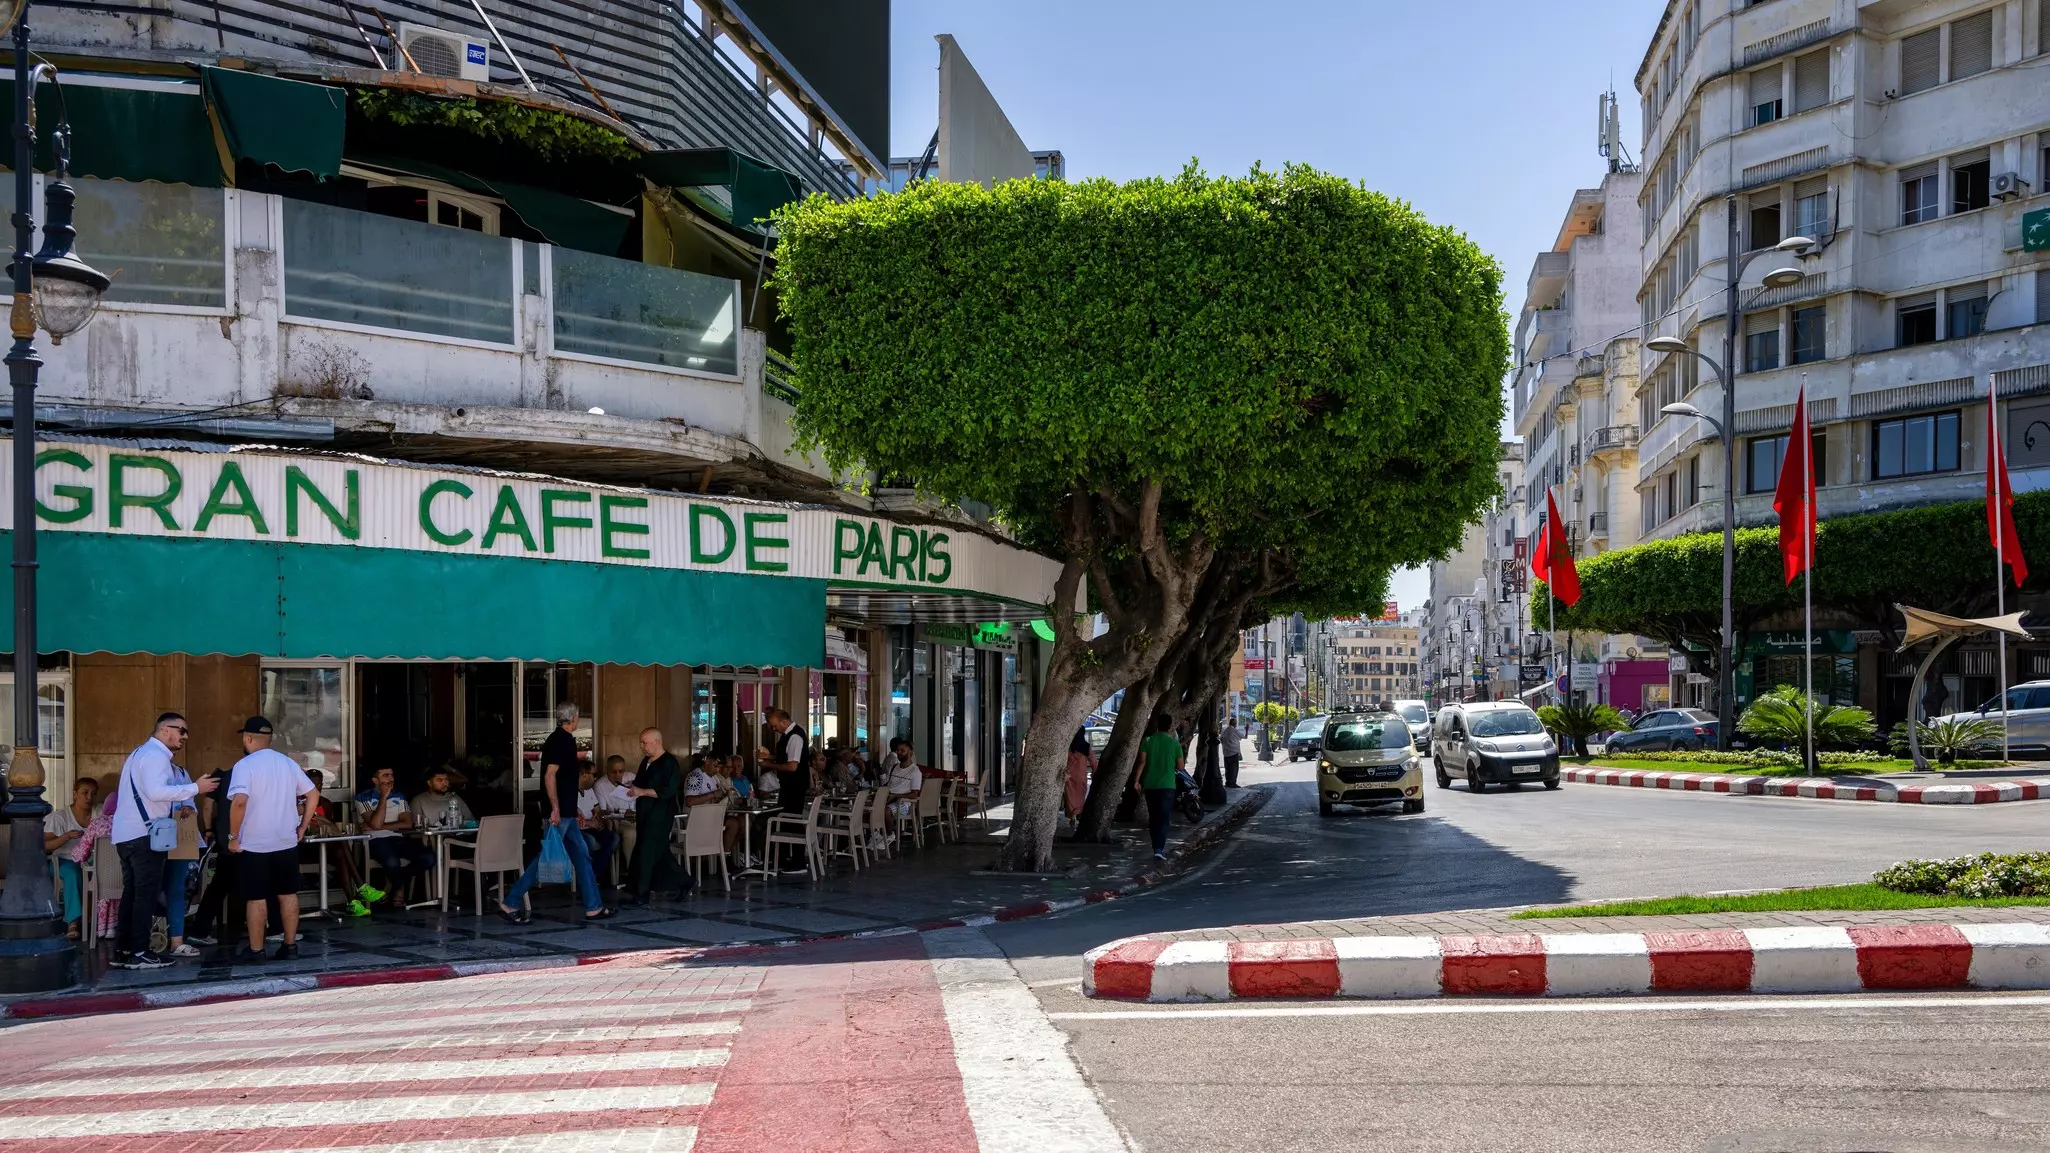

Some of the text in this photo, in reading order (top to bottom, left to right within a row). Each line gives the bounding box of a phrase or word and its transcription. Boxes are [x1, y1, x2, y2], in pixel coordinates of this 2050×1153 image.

[35, 448, 952, 584] GRAN CAFE DE PARIS
[1766, 632, 1822, 649] صيدلية
